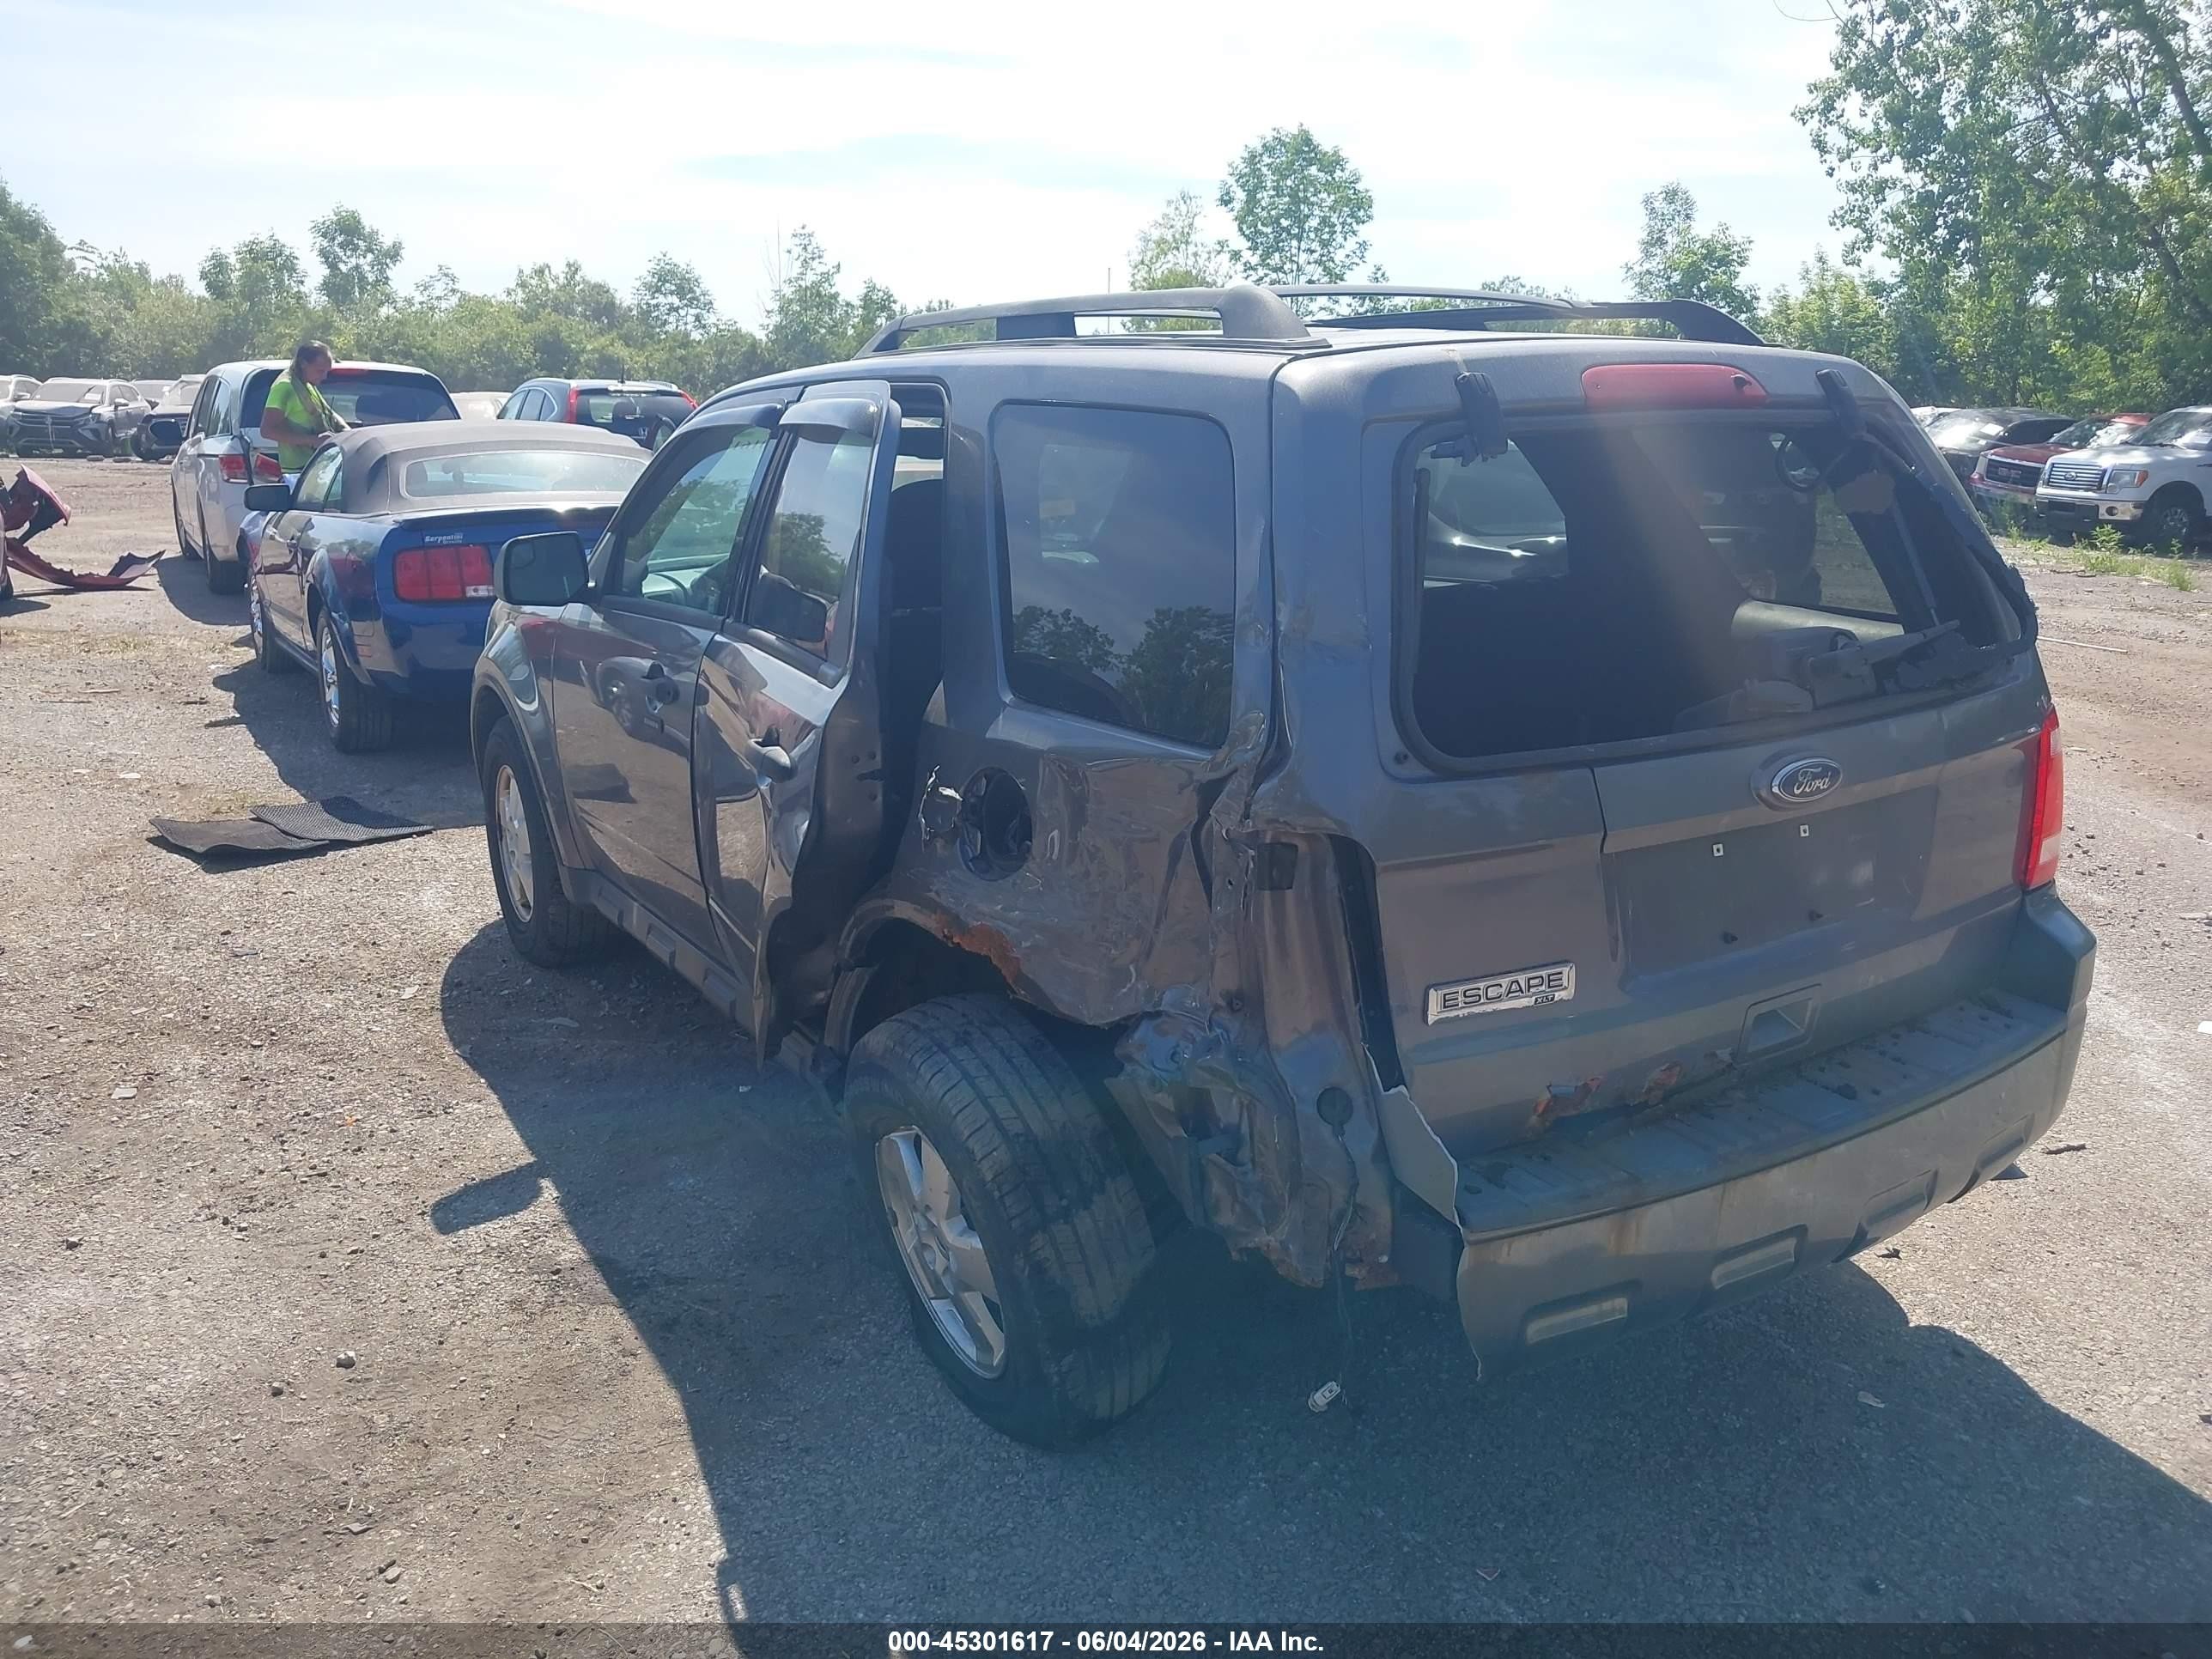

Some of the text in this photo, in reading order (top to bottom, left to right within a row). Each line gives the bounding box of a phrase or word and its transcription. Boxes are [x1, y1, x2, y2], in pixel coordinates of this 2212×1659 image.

[1793, 767, 1832, 794] Ford
[1442, 971, 1565, 1010] ESCAPE
[1535, 994, 1554, 1004] XLT
